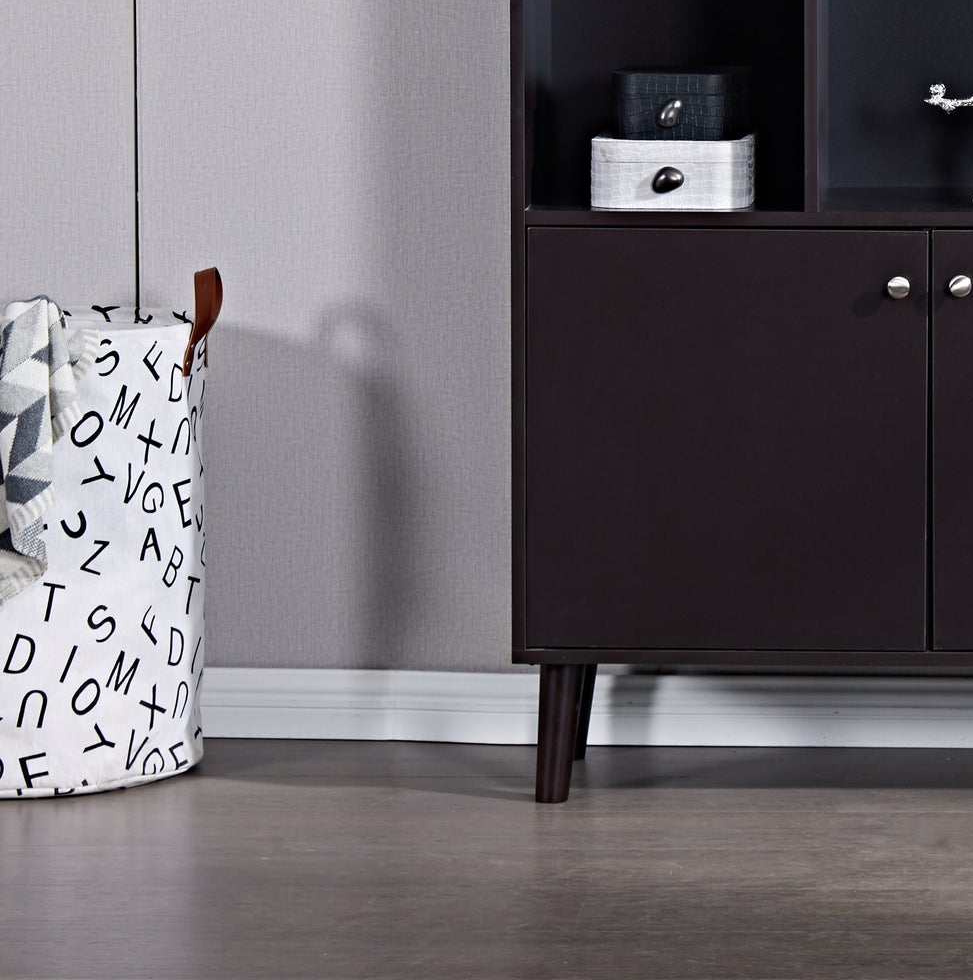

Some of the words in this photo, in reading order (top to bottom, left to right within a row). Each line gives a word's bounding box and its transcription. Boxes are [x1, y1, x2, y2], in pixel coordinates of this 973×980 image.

[95, 339, 120, 377] S
[109, 384, 141, 429] M
[71, 411, 104, 448] O
[137, 418, 163, 465] X
[81, 456, 116, 485] Y
[124, 463, 145, 505] V
[142, 482, 164, 513] G
[173, 478, 192, 528] E
[140, 528, 161, 561] A
[162, 545, 184, 588] B
[43, 581, 66, 622] T
[87, 604, 116, 643] S
[3, 633, 36, 674] D
[167, 626, 184, 666] D
[105, 650, 140, 695] M
[71, 678, 100, 716] O
[139, 683, 167, 732] X
[83, 722, 116, 753] Y
[125, 729, 149, 771] V
